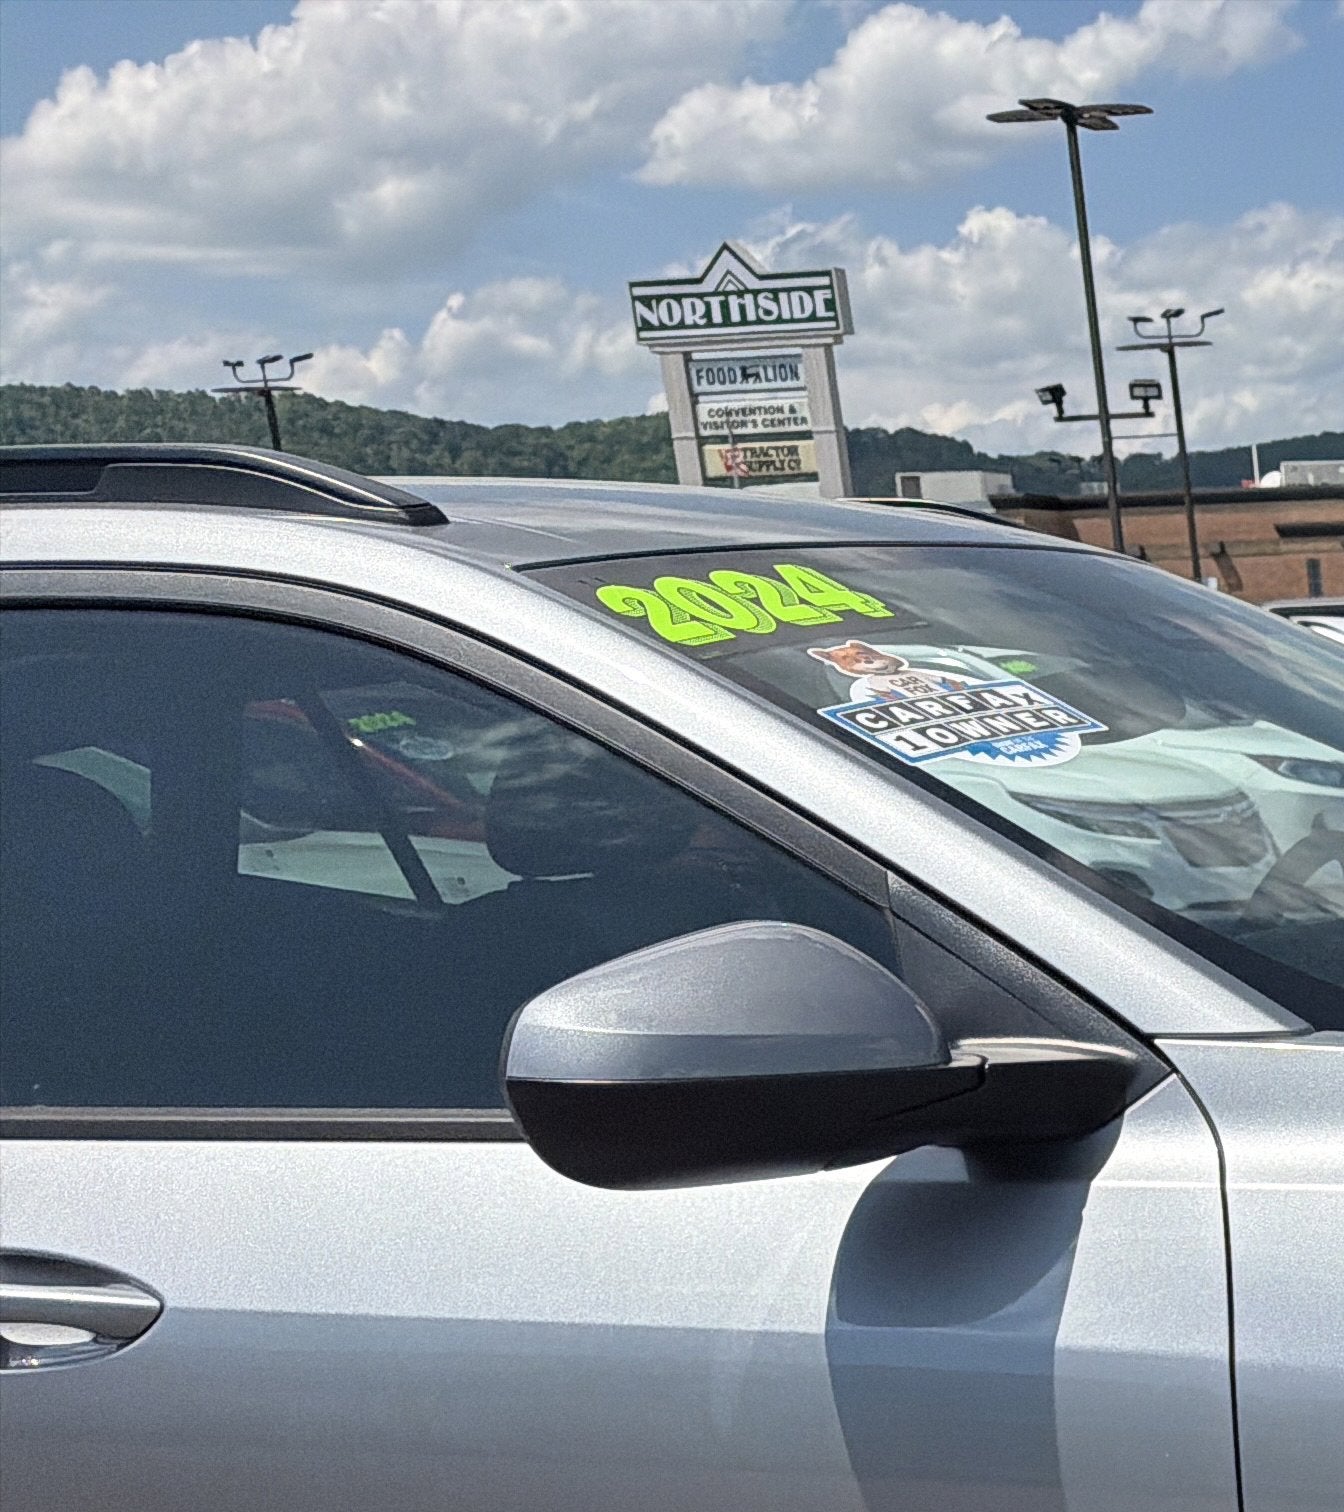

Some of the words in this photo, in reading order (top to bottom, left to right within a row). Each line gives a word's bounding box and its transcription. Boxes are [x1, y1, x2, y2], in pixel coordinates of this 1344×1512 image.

[634, 288, 835, 328] NORTHSIDE
[696, 367, 737, 386] FOOD
[763, 363, 801, 382] LION
[707, 404, 785, 418] CONVENTION
[761, 416, 809, 428] CENTER
[596, 564, 895, 646] 2024
[888, 675, 926, 688] CAR
[903, 683, 940, 696] FOX
[854, 688, 1040, 731] CARFAX
[891, 733, 929, 752] 1
[924, 708, 1080, 745] OWNER
